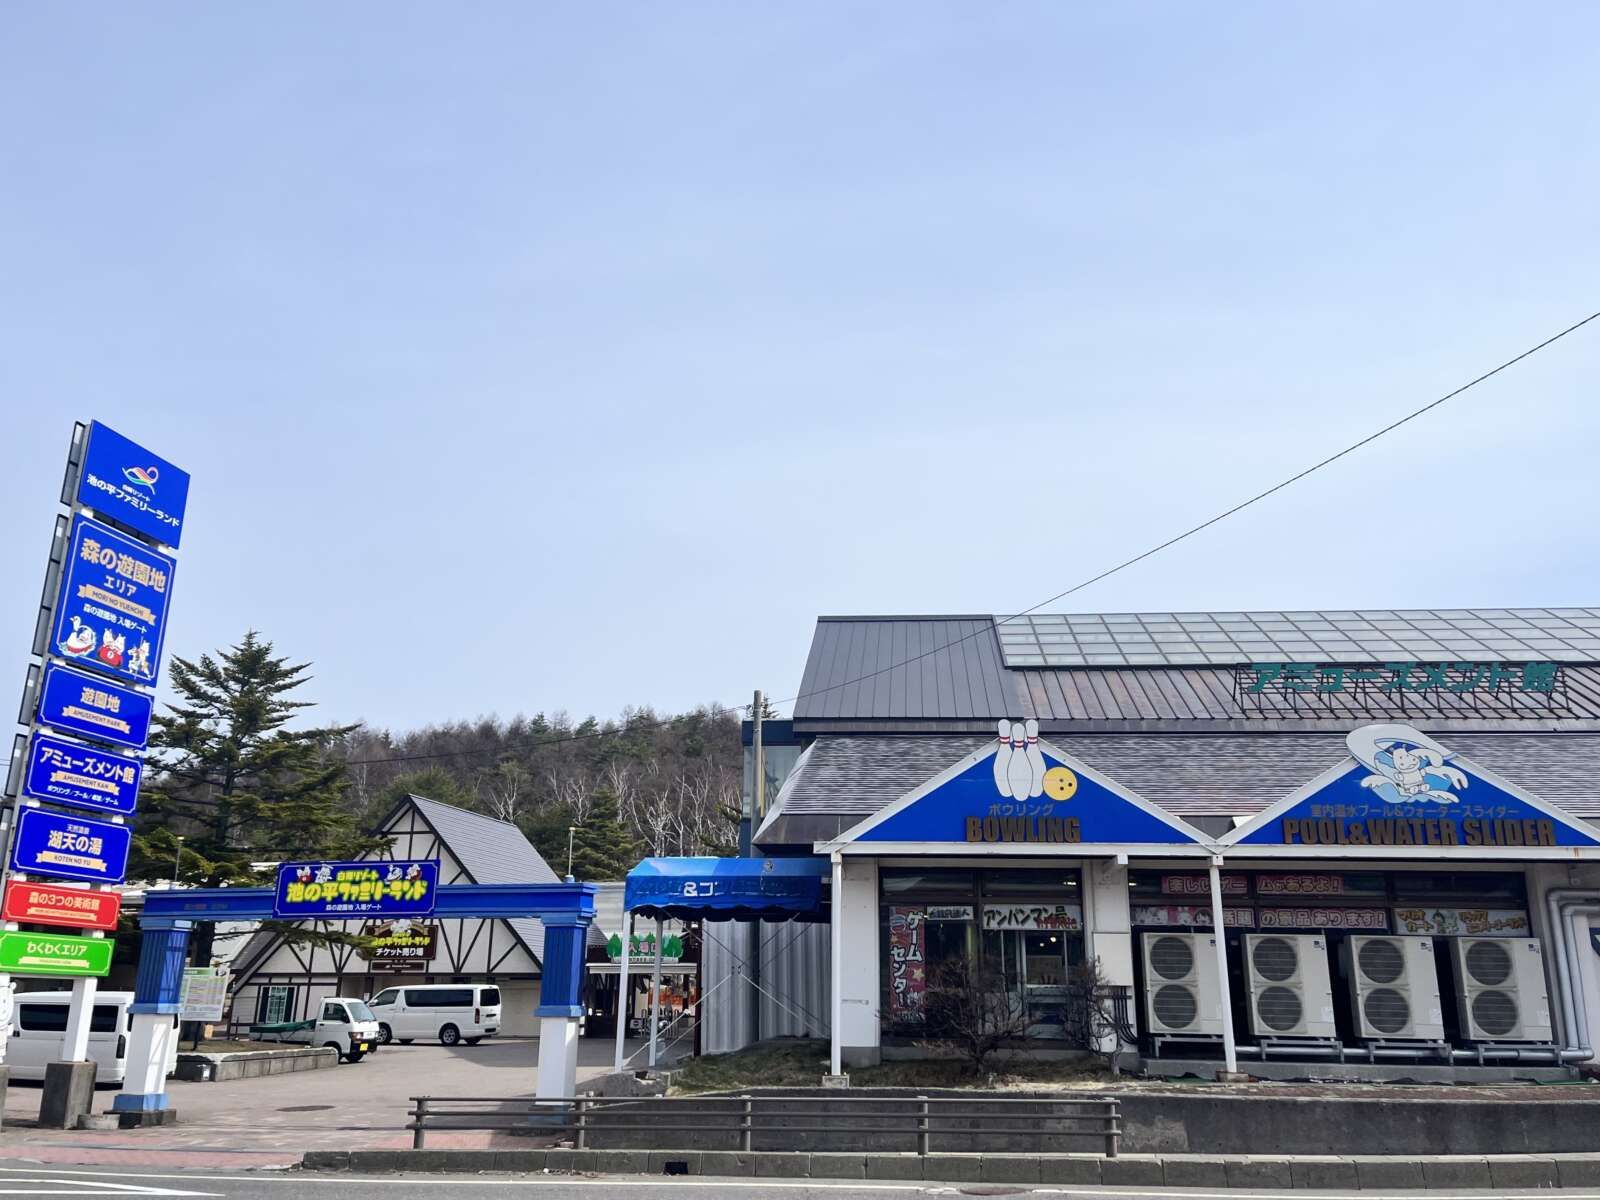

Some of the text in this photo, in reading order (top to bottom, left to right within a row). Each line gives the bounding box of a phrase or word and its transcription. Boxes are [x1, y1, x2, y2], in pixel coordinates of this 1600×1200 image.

[86, 473, 180, 527] 池の平ファミリーランド
[81, 538, 166, 593] 森の遊園地
[103, 575, 137, 597] エリア
[81, 686, 120, 714] 遊園地
[40, 746, 136, 785] アミューズメント館
[989, 803, 1055, 817] ボウリング
[48, 830, 103, 856] 湖天の湯
[965, 816, 1080, 843] BOWLING
[1463, 819, 1557, 847] SLIDER
[286, 880, 428, 903] 池の平ファミリーランド
[27, 941, 88, 957] わくわくエリア
[907, 911, 924, 963] ゲーム
